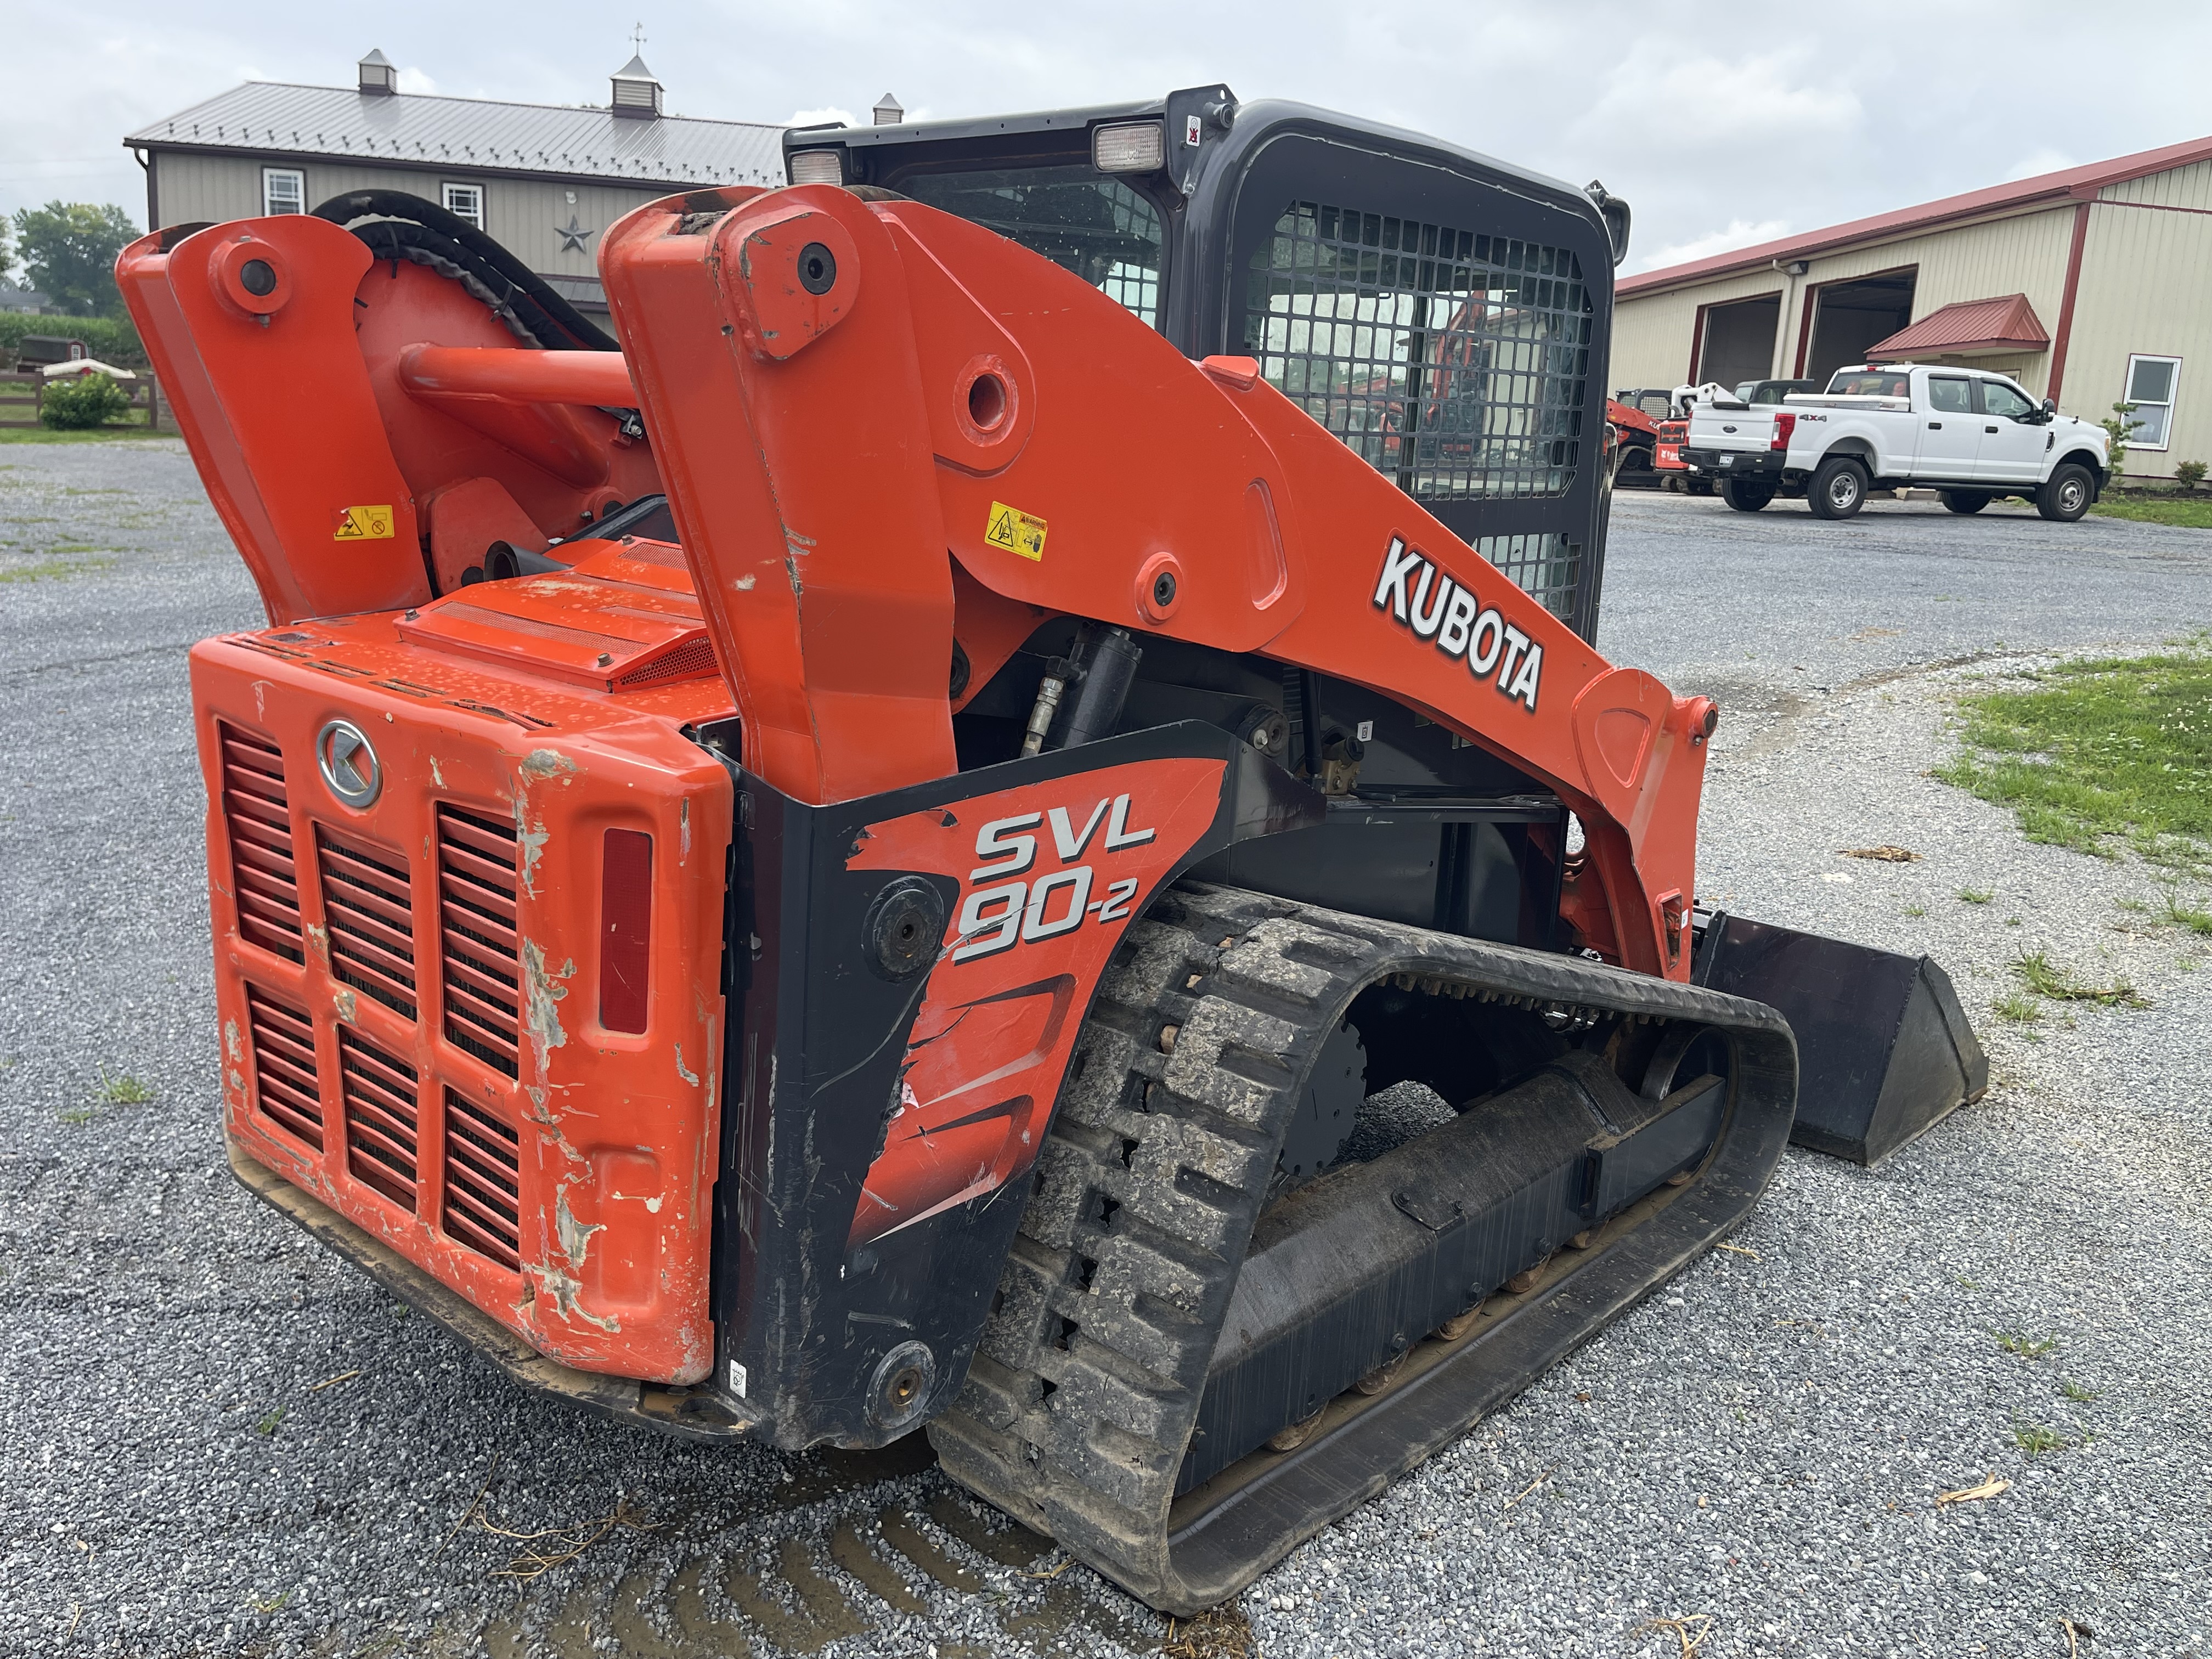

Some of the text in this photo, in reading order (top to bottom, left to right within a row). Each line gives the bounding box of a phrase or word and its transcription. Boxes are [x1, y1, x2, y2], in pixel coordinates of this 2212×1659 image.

[1025, 516, 1045, 529] WARNING
[1374, 538, 1543, 710] KUBOTA
[968, 793, 1155, 883] SVL
[951, 866, 1138, 964] 90-2
